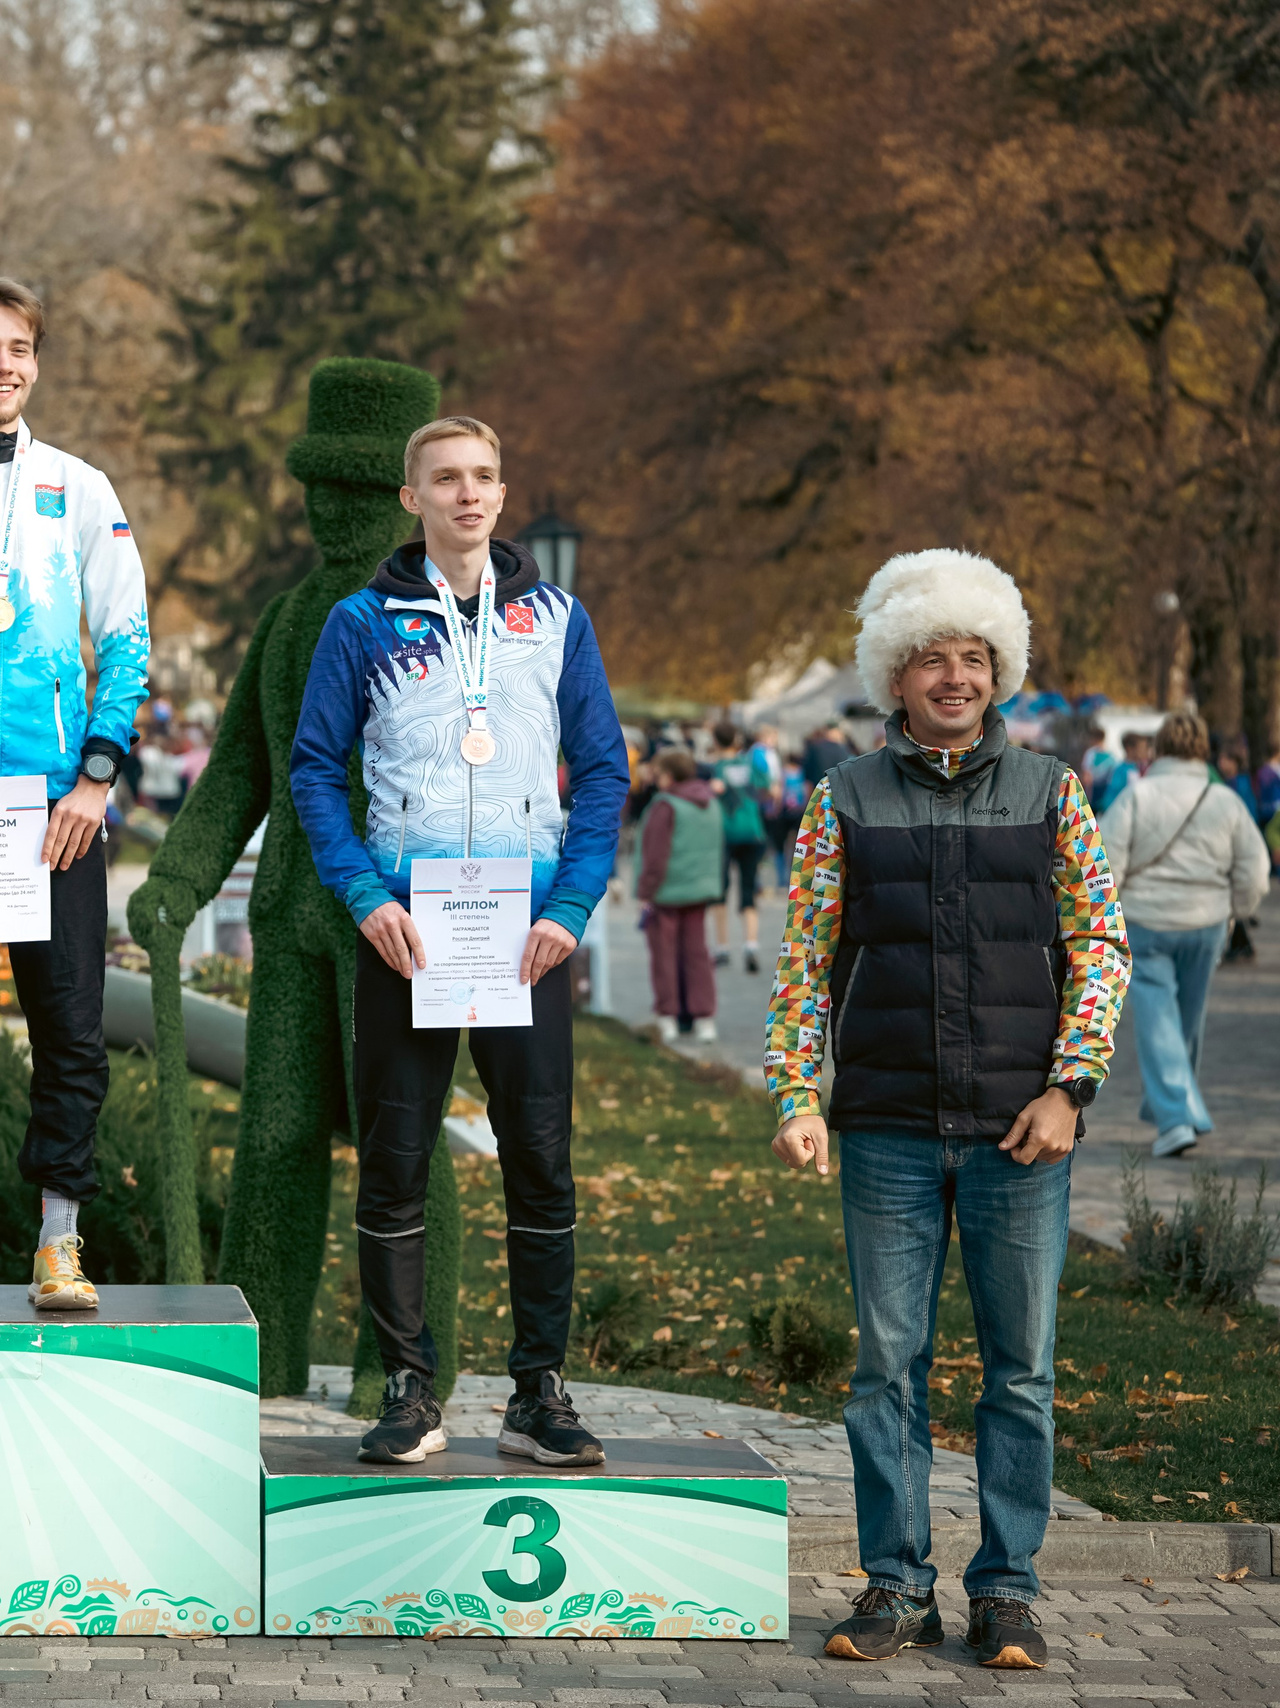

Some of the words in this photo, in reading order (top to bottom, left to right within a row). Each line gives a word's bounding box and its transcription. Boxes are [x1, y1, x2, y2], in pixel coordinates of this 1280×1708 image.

[444, 594, 458, 638] МИНИСТЕРСТВО
[455, 639, 465, 662] СПОРТА
[461, 662, 471, 688] РОССИИ
[479, 640, 487, 687] МИНИСТЕРСТВО
[406, 673, 419, 681] SFR
[442, 901, 498, 911] ДИПЛОМ
[482, 1495, 566, 1602] 3
